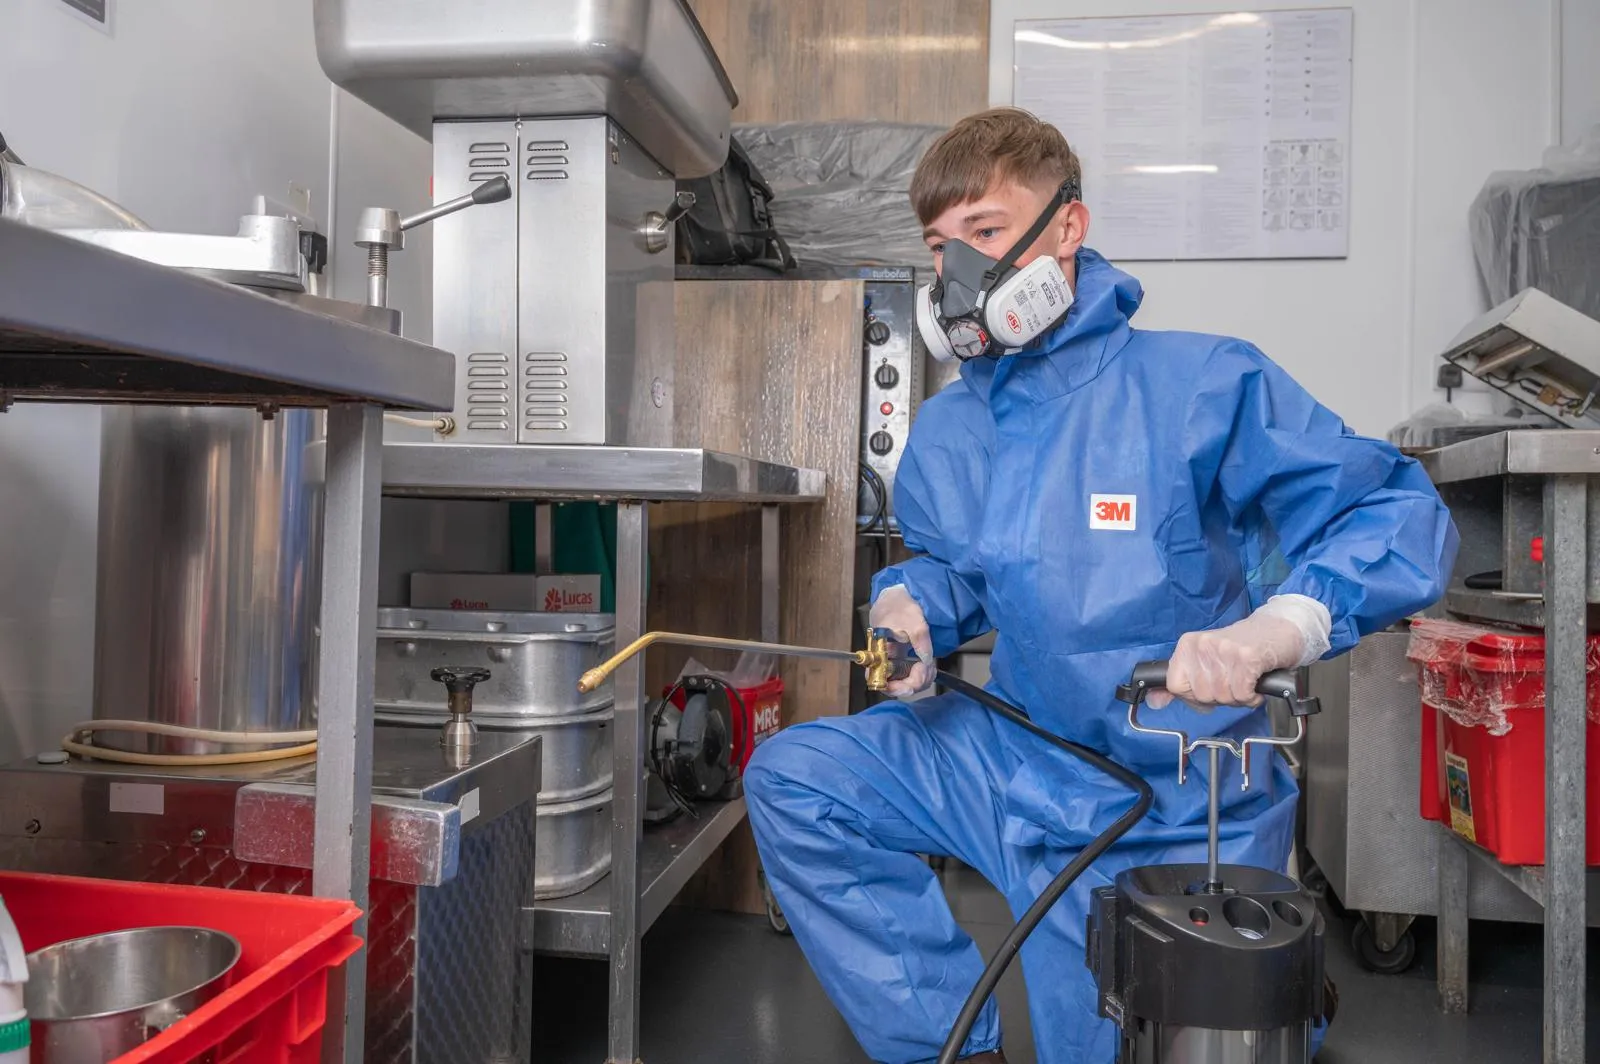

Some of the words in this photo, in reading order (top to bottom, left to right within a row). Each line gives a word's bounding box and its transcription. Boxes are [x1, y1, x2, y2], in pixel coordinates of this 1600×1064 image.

[872, 268, 910, 279] turbofan
[1007, 313, 1020, 330] JSP
[1095, 502, 1130, 521] 3M
[563, 589, 593, 605] Lucas
[753, 703, 779, 733] MRC
